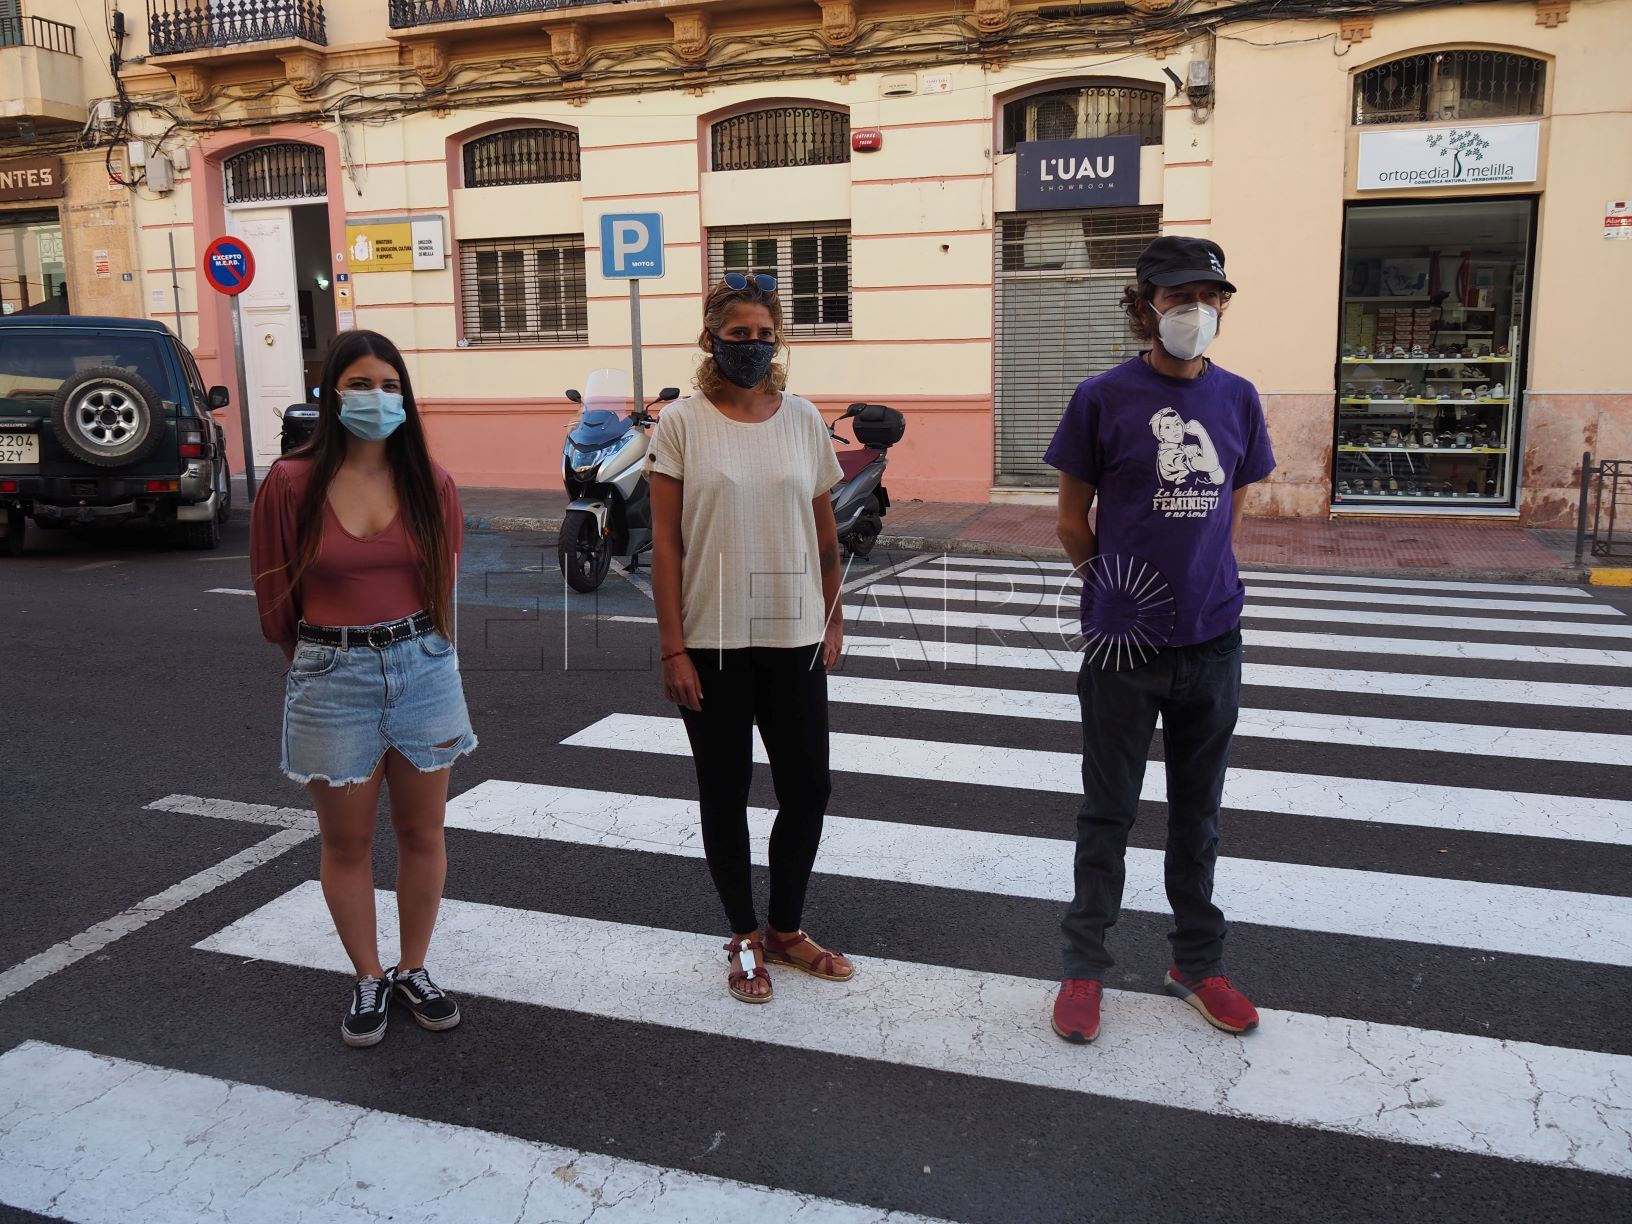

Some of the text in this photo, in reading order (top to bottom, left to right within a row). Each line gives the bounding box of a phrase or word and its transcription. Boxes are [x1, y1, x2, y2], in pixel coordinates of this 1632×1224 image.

[0, 168, 53, 189] NTES
[1378, 163, 1514, 183] ortopedia melilla
[1040, 183, 1114, 191] SHOWROOM
[612, 220, 649, 271] P
[1154, 488, 1170, 498] La
[1172, 487, 1199, 497] lucha
